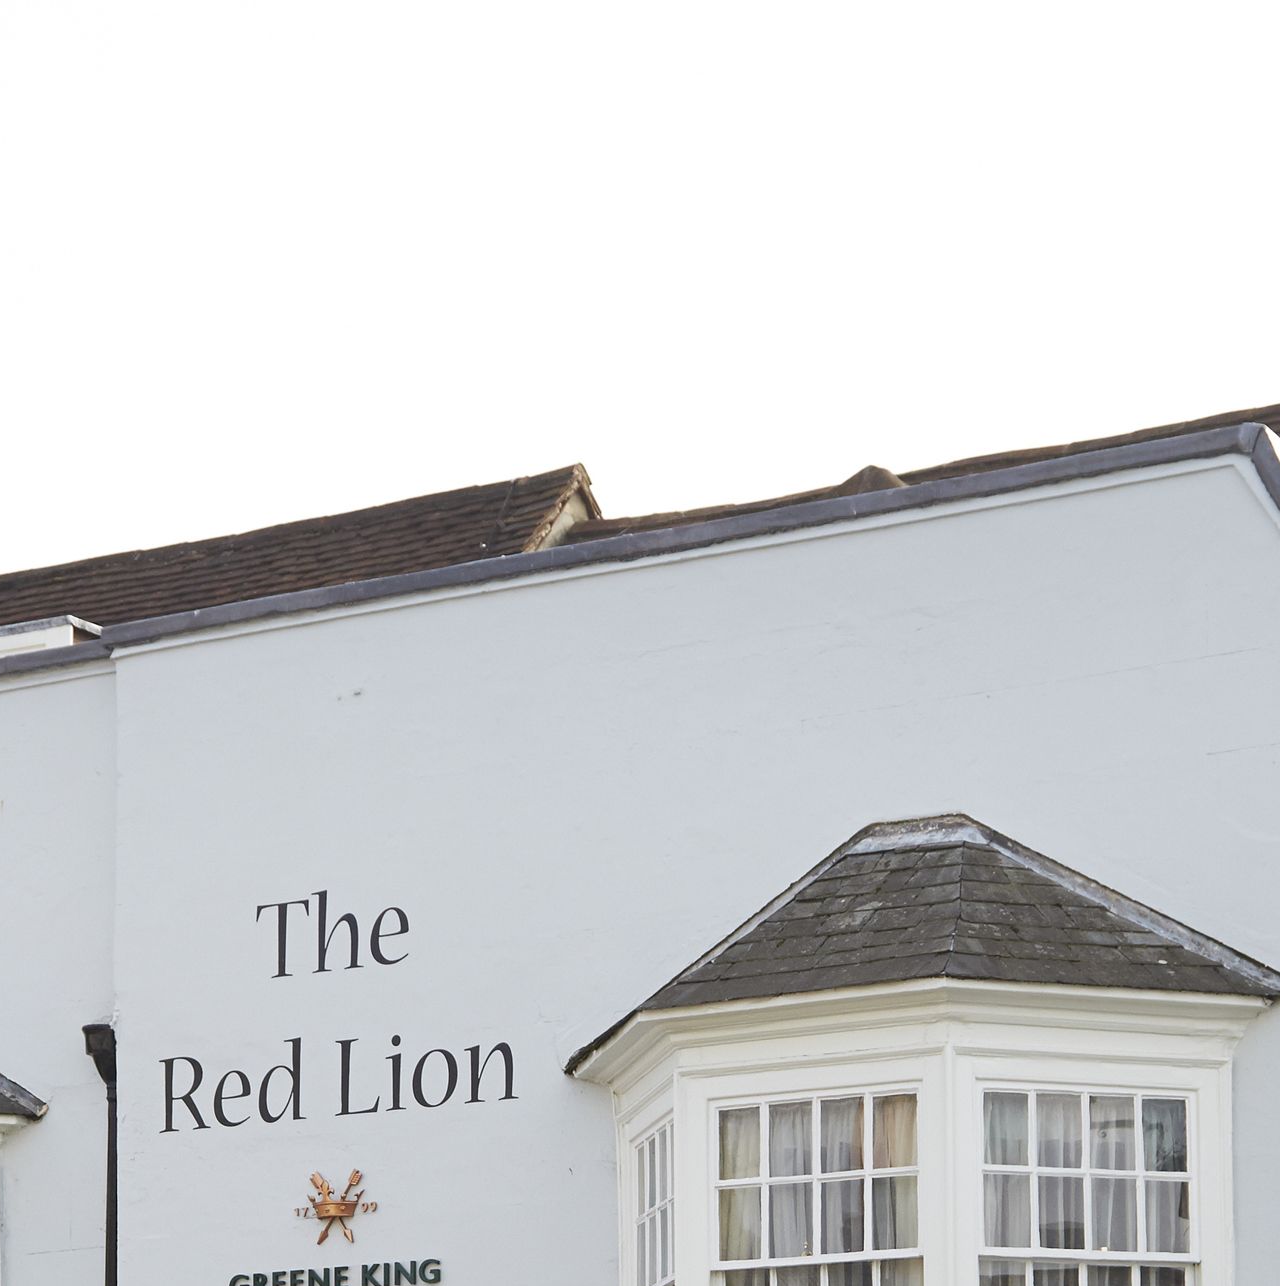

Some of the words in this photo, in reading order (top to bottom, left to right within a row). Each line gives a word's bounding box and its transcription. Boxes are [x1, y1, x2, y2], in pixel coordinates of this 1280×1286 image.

[255, 889, 410, 979] The
[158, 1036, 307, 1134] Red
[335, 1033, 519, 1118] Lion
